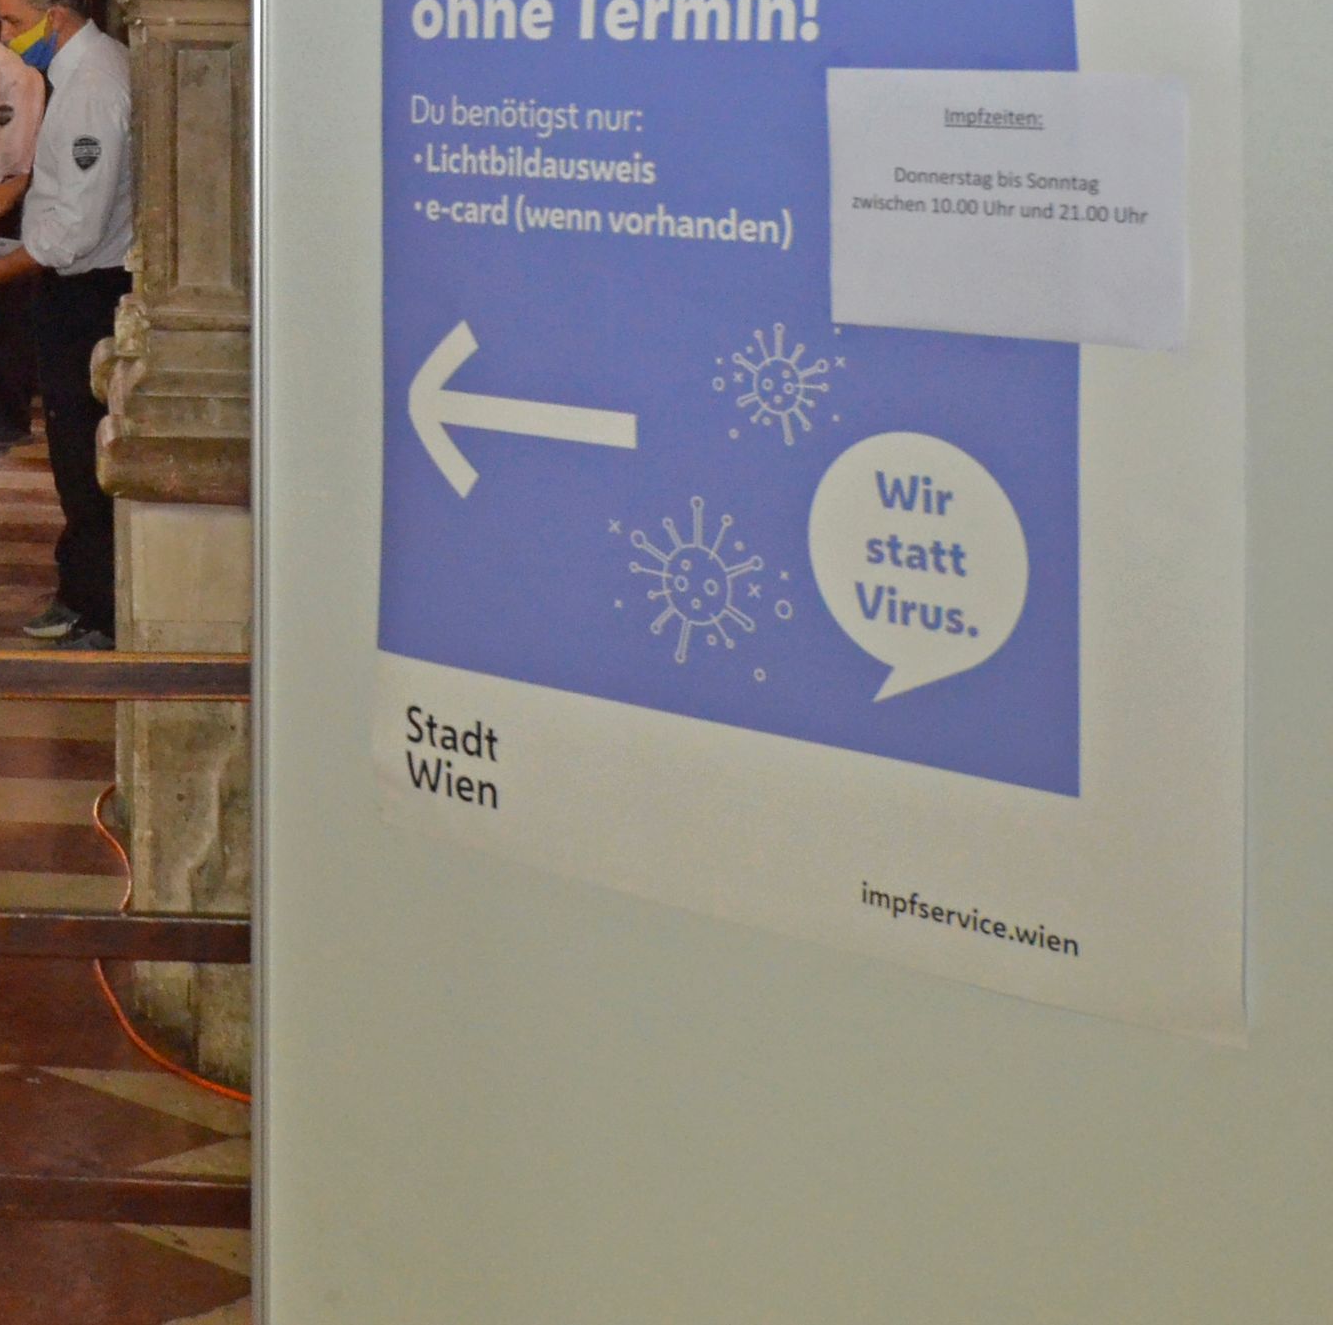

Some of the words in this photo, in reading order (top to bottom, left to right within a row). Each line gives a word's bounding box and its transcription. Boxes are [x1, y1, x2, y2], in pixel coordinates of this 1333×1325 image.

[411, 94, 445, 125] Du
[451, 95, 579, 138] benötigst
[586, 107, 644, 133] nur:
[944, 108, 1044, 130] Impfzeiten:
[426, 144, 657, 184] Lichtbildausweis
[894, 167, 993, 190] Donnerstag
[996, 170, 1022, 189] bis
[1027, 173, 1100, 195] Sonntag
[426, 195, 509, 226] e-card
[515, 195, 601, 233] (wenn
[609, 204, 794, 250] vorhanden)
[852, 194, 926, 213] zwischen
[932, 198, 978, 216] 10.00
[983, 200, 1015, 217] Uhr
[1020, 203, 1053, 220] und
[1058, 204, 1108, 222] 21.00
[1114, 207, 1148, 225] Uhr
[875, 470, 953, 516] Wir
[866, 534, 966, 577] statt
[855, 580, 979, 638] Virus.
[407, 705, 498, 762] Stadt
[406, 749, 497, 809] Wien
[862, 881, 1081, 957] impfservice.wien
